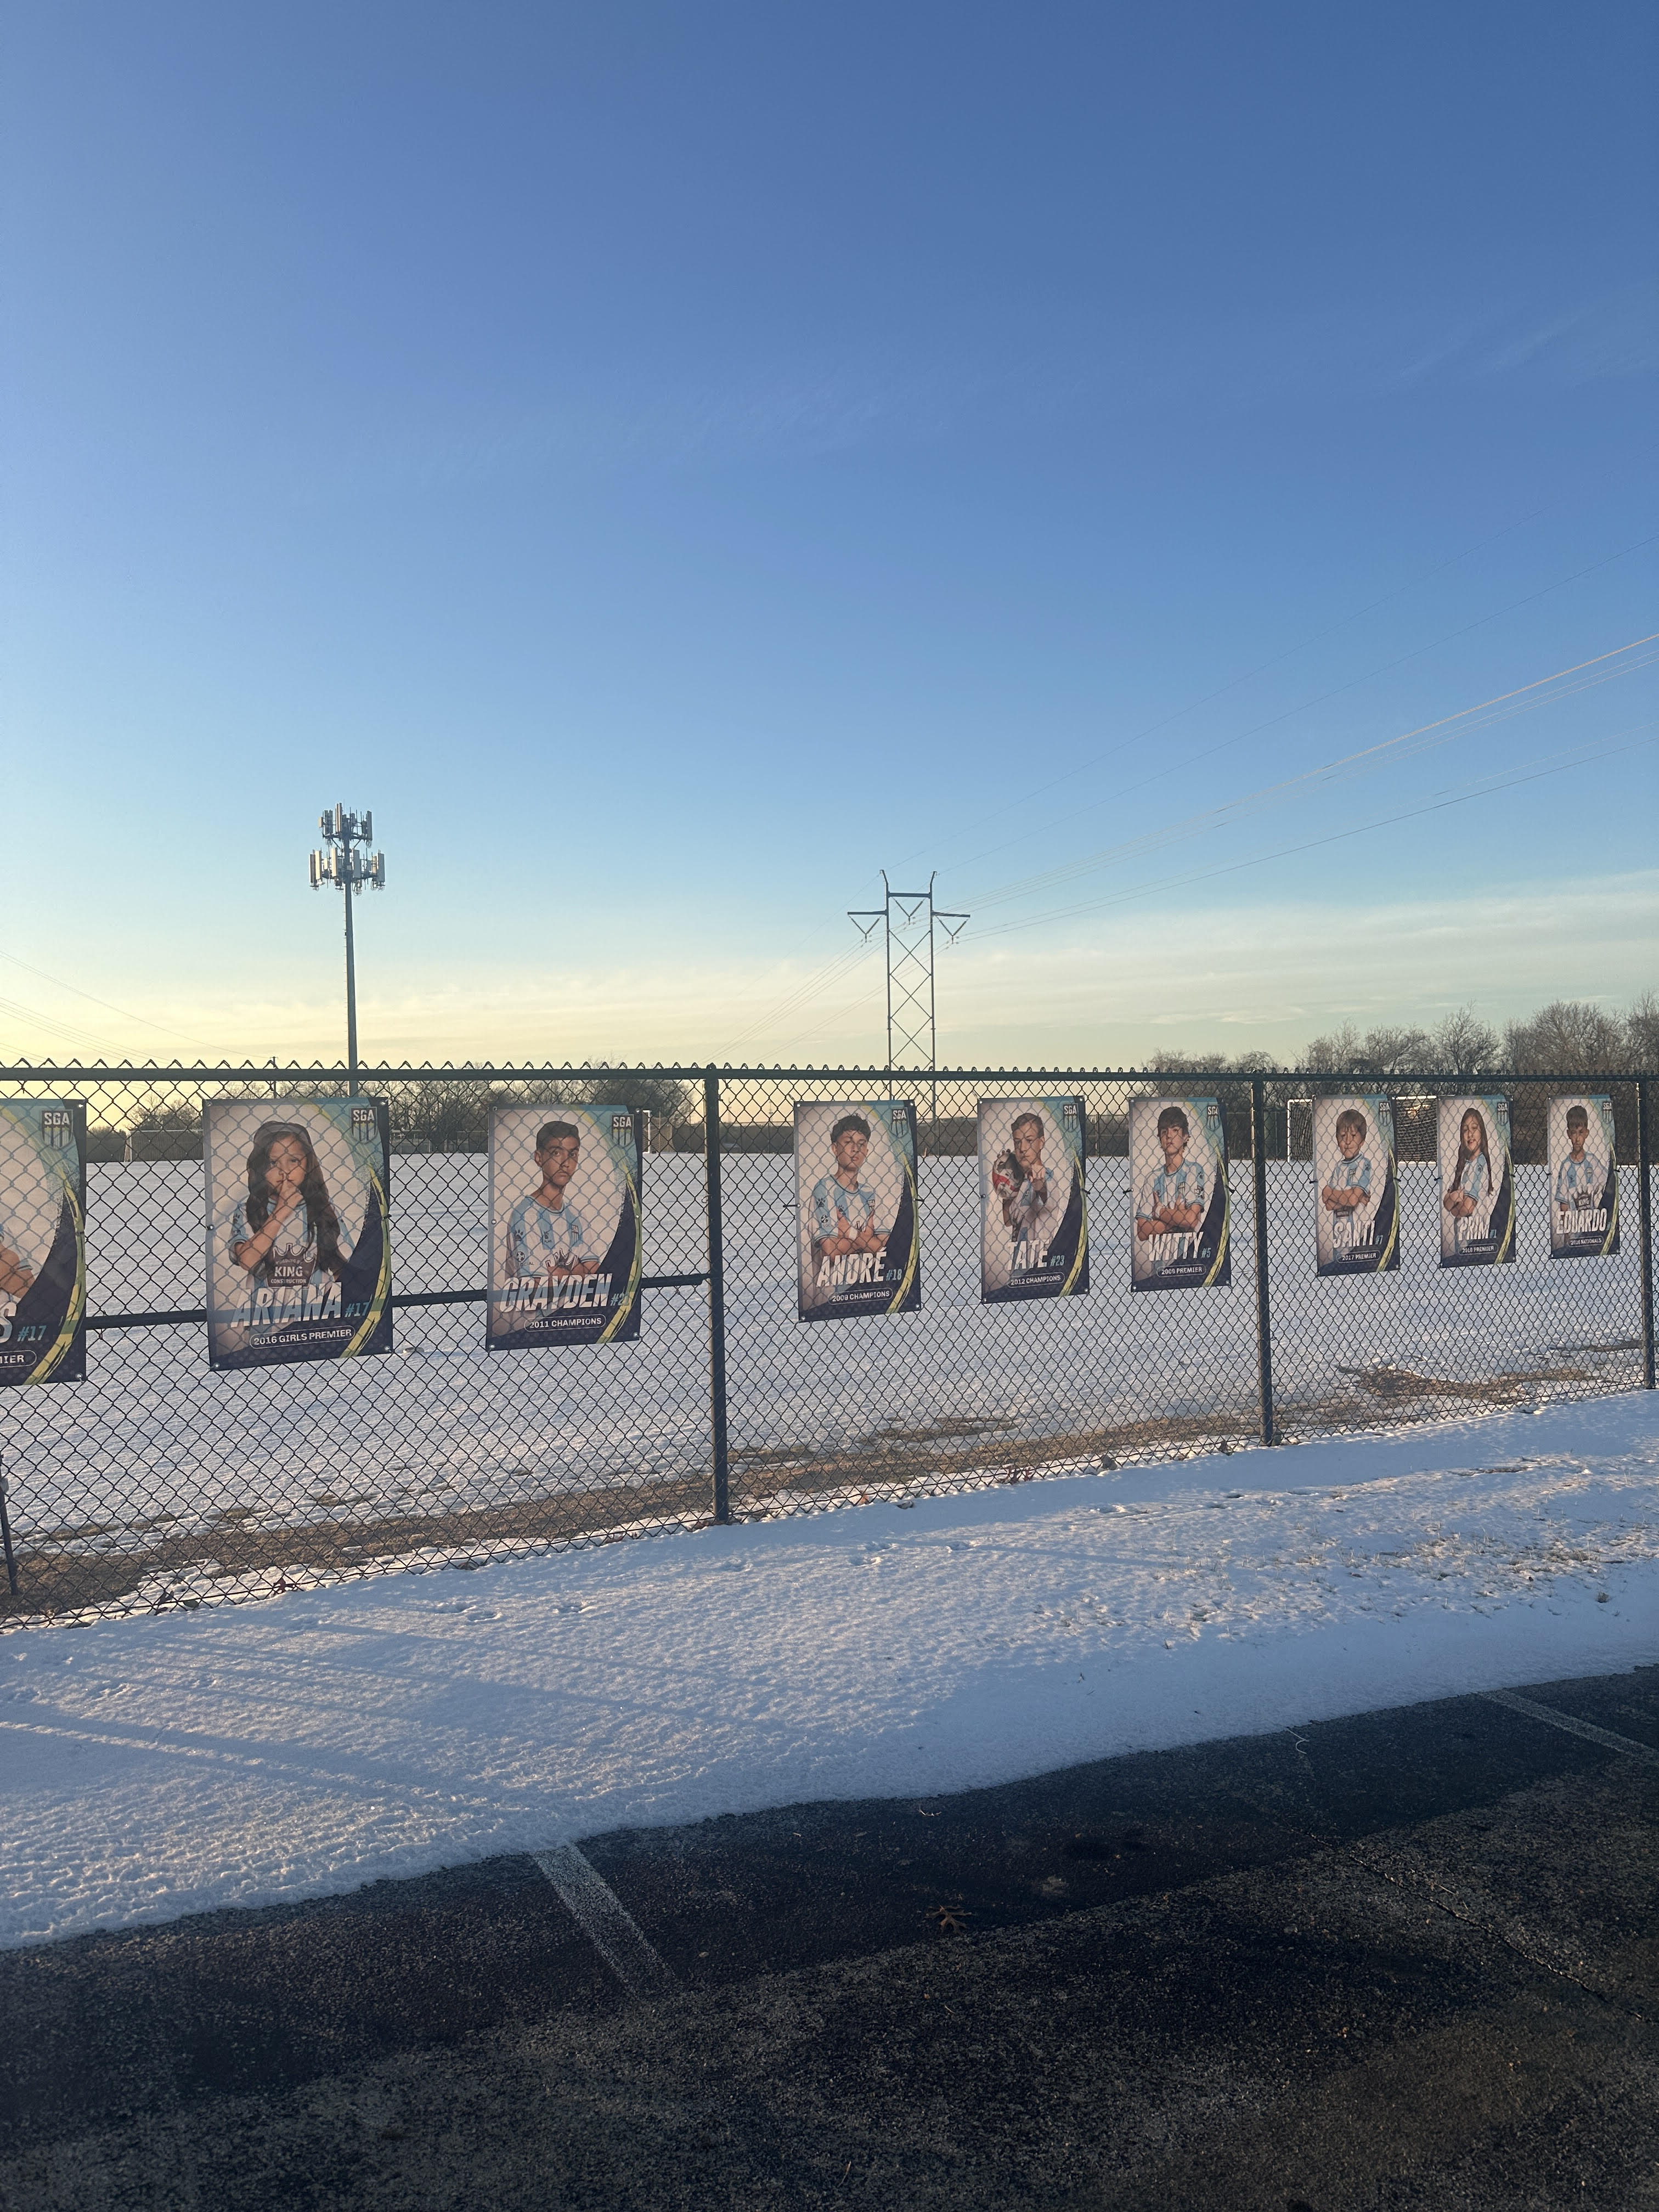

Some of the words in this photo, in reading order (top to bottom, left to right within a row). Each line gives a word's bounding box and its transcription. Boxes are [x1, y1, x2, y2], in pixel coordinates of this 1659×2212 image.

[1064, 1105, 1077, 1114] SGA
[1498, 1103, 1508, 1111] SGA
[44, 1113, 70, 1125] SGA
[353, 1109, 374, 1121] SGA
[613, 1116, 631, 1127] SGA
[893, 1110, 906, 1119] SGA
[1458, 1216, 1491, 1240] PRIM
[1556, 1208, 1607, 1234] EDUARDO
[1333, 1219, 1375, 1248] SANTI
[1149, 1232, 1204, 1261] WITTY
[1201, 1248, 1211, 1259] #5
[1007, 1239, 1050, 1271] TATE
[1050, 1255, 1065, 1267] #23
[274, 1266, 303, 1277] KING
[816, 1246, 887, 1288] ANDRÉ
[885, 1268, 902, 1281] #18
[1026, 1275, 1061, 1284] CHAMPIONS
[499, 1273, 613, 1313] GRAYDEN
[849, 1290, 890, 1300] CHAMPIONS
[230, 1282, 342, 1328] ARIANA
[345, 1302, 369, 1318] #17
[529, 1321, 549, 1329] 2011
[551, 1318, 602, 1327] CHAMPIONS
[17, 1325, 47, 1342] #17
[253, 1334, 277, 1345] 2016
[279, 1331, 307, 1342] GIRLS
[309, 1329, 352, 1340] PREMIER
